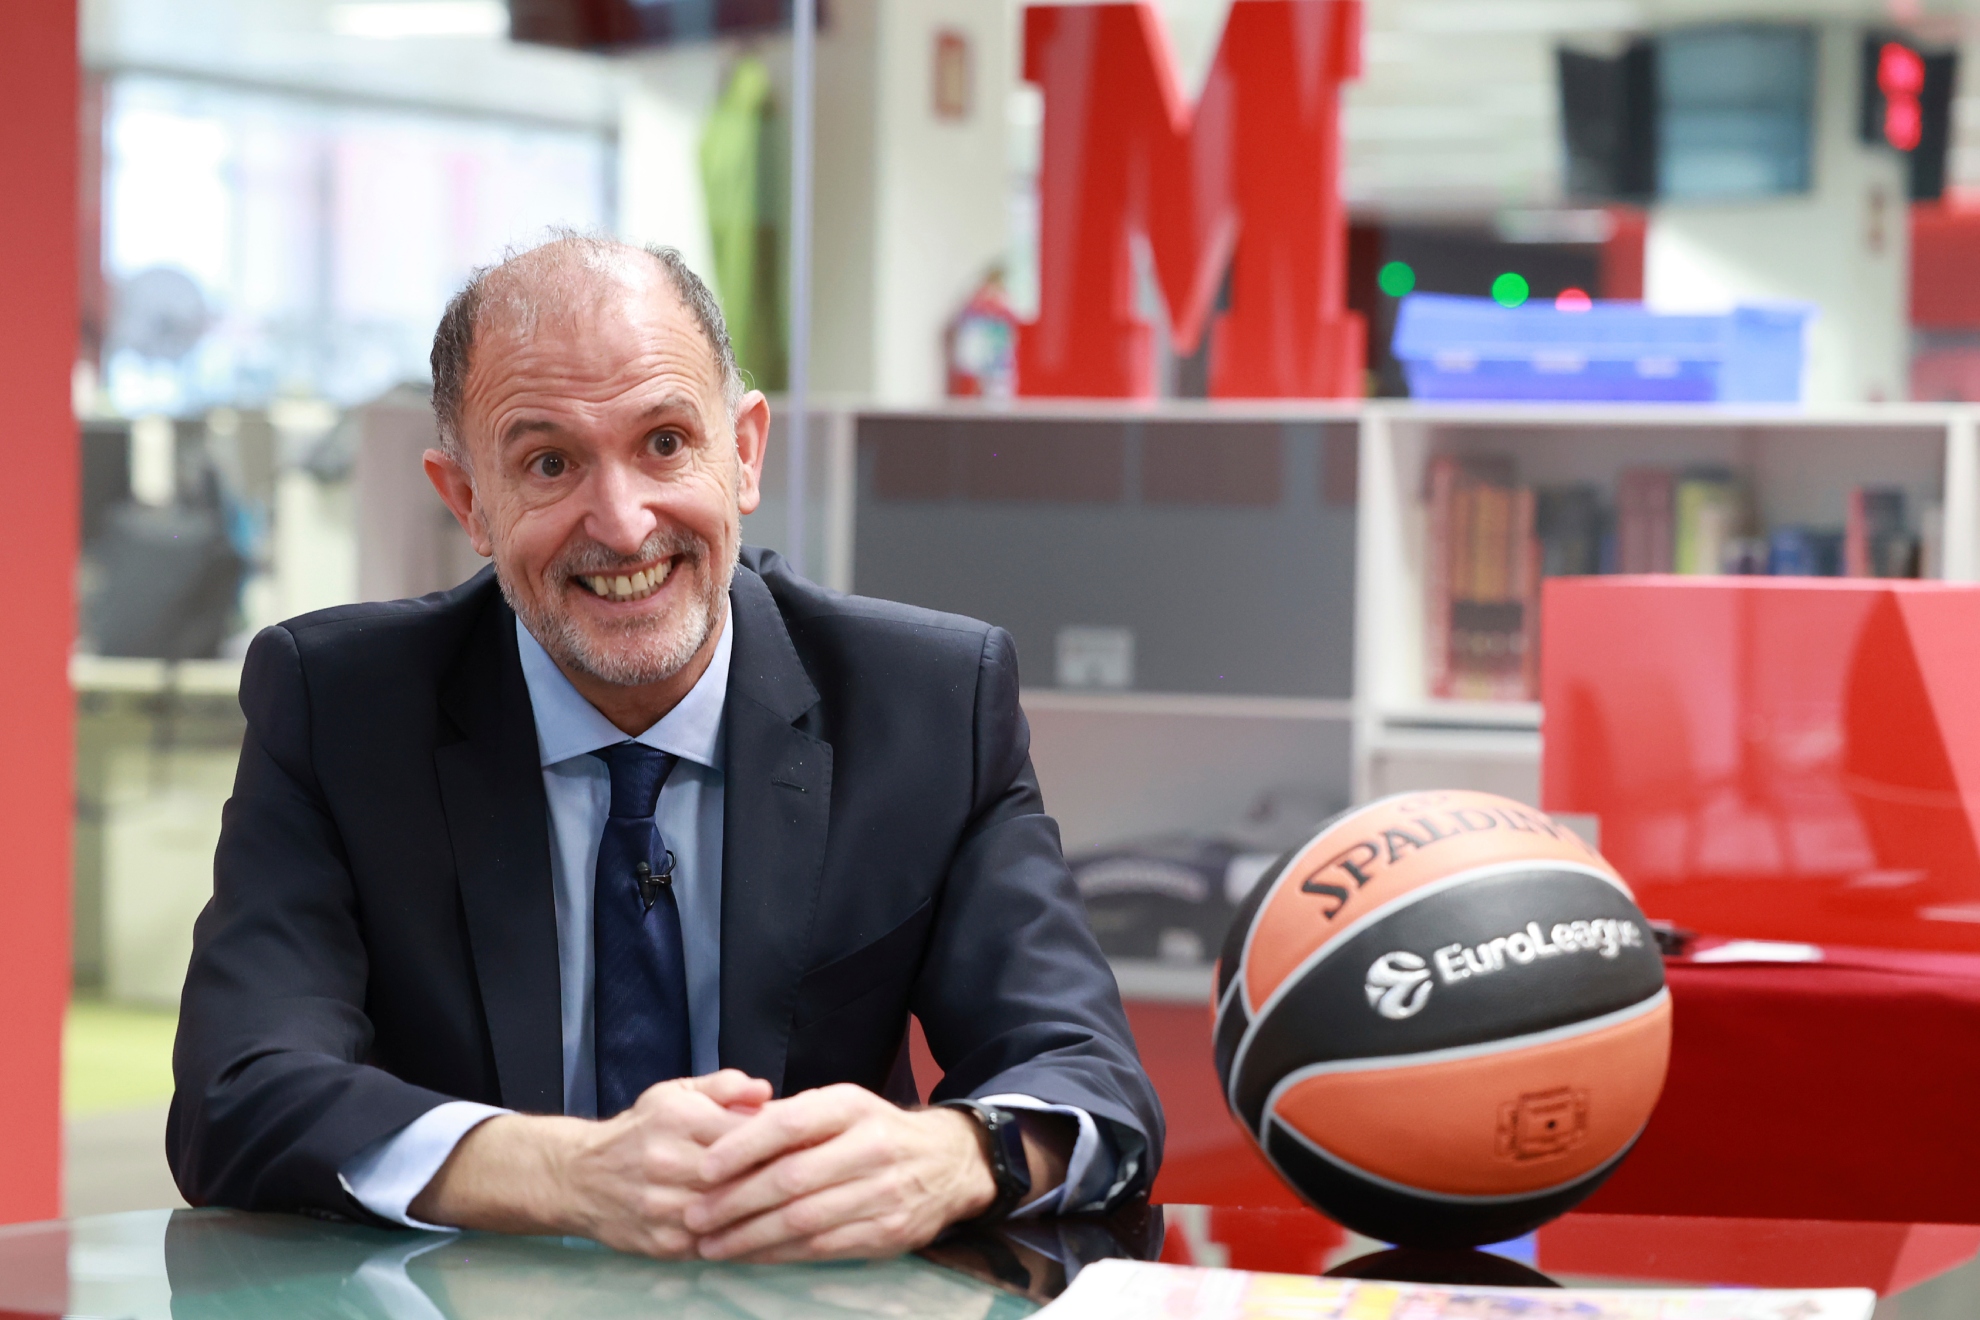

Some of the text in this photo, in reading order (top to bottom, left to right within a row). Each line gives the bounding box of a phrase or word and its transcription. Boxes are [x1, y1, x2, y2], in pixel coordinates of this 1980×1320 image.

[1016, 0, 1366, 400] M
[1301, 807, 1598, 921] SPALDIN
[1433, 918, 1644, 986] EuroLeague
